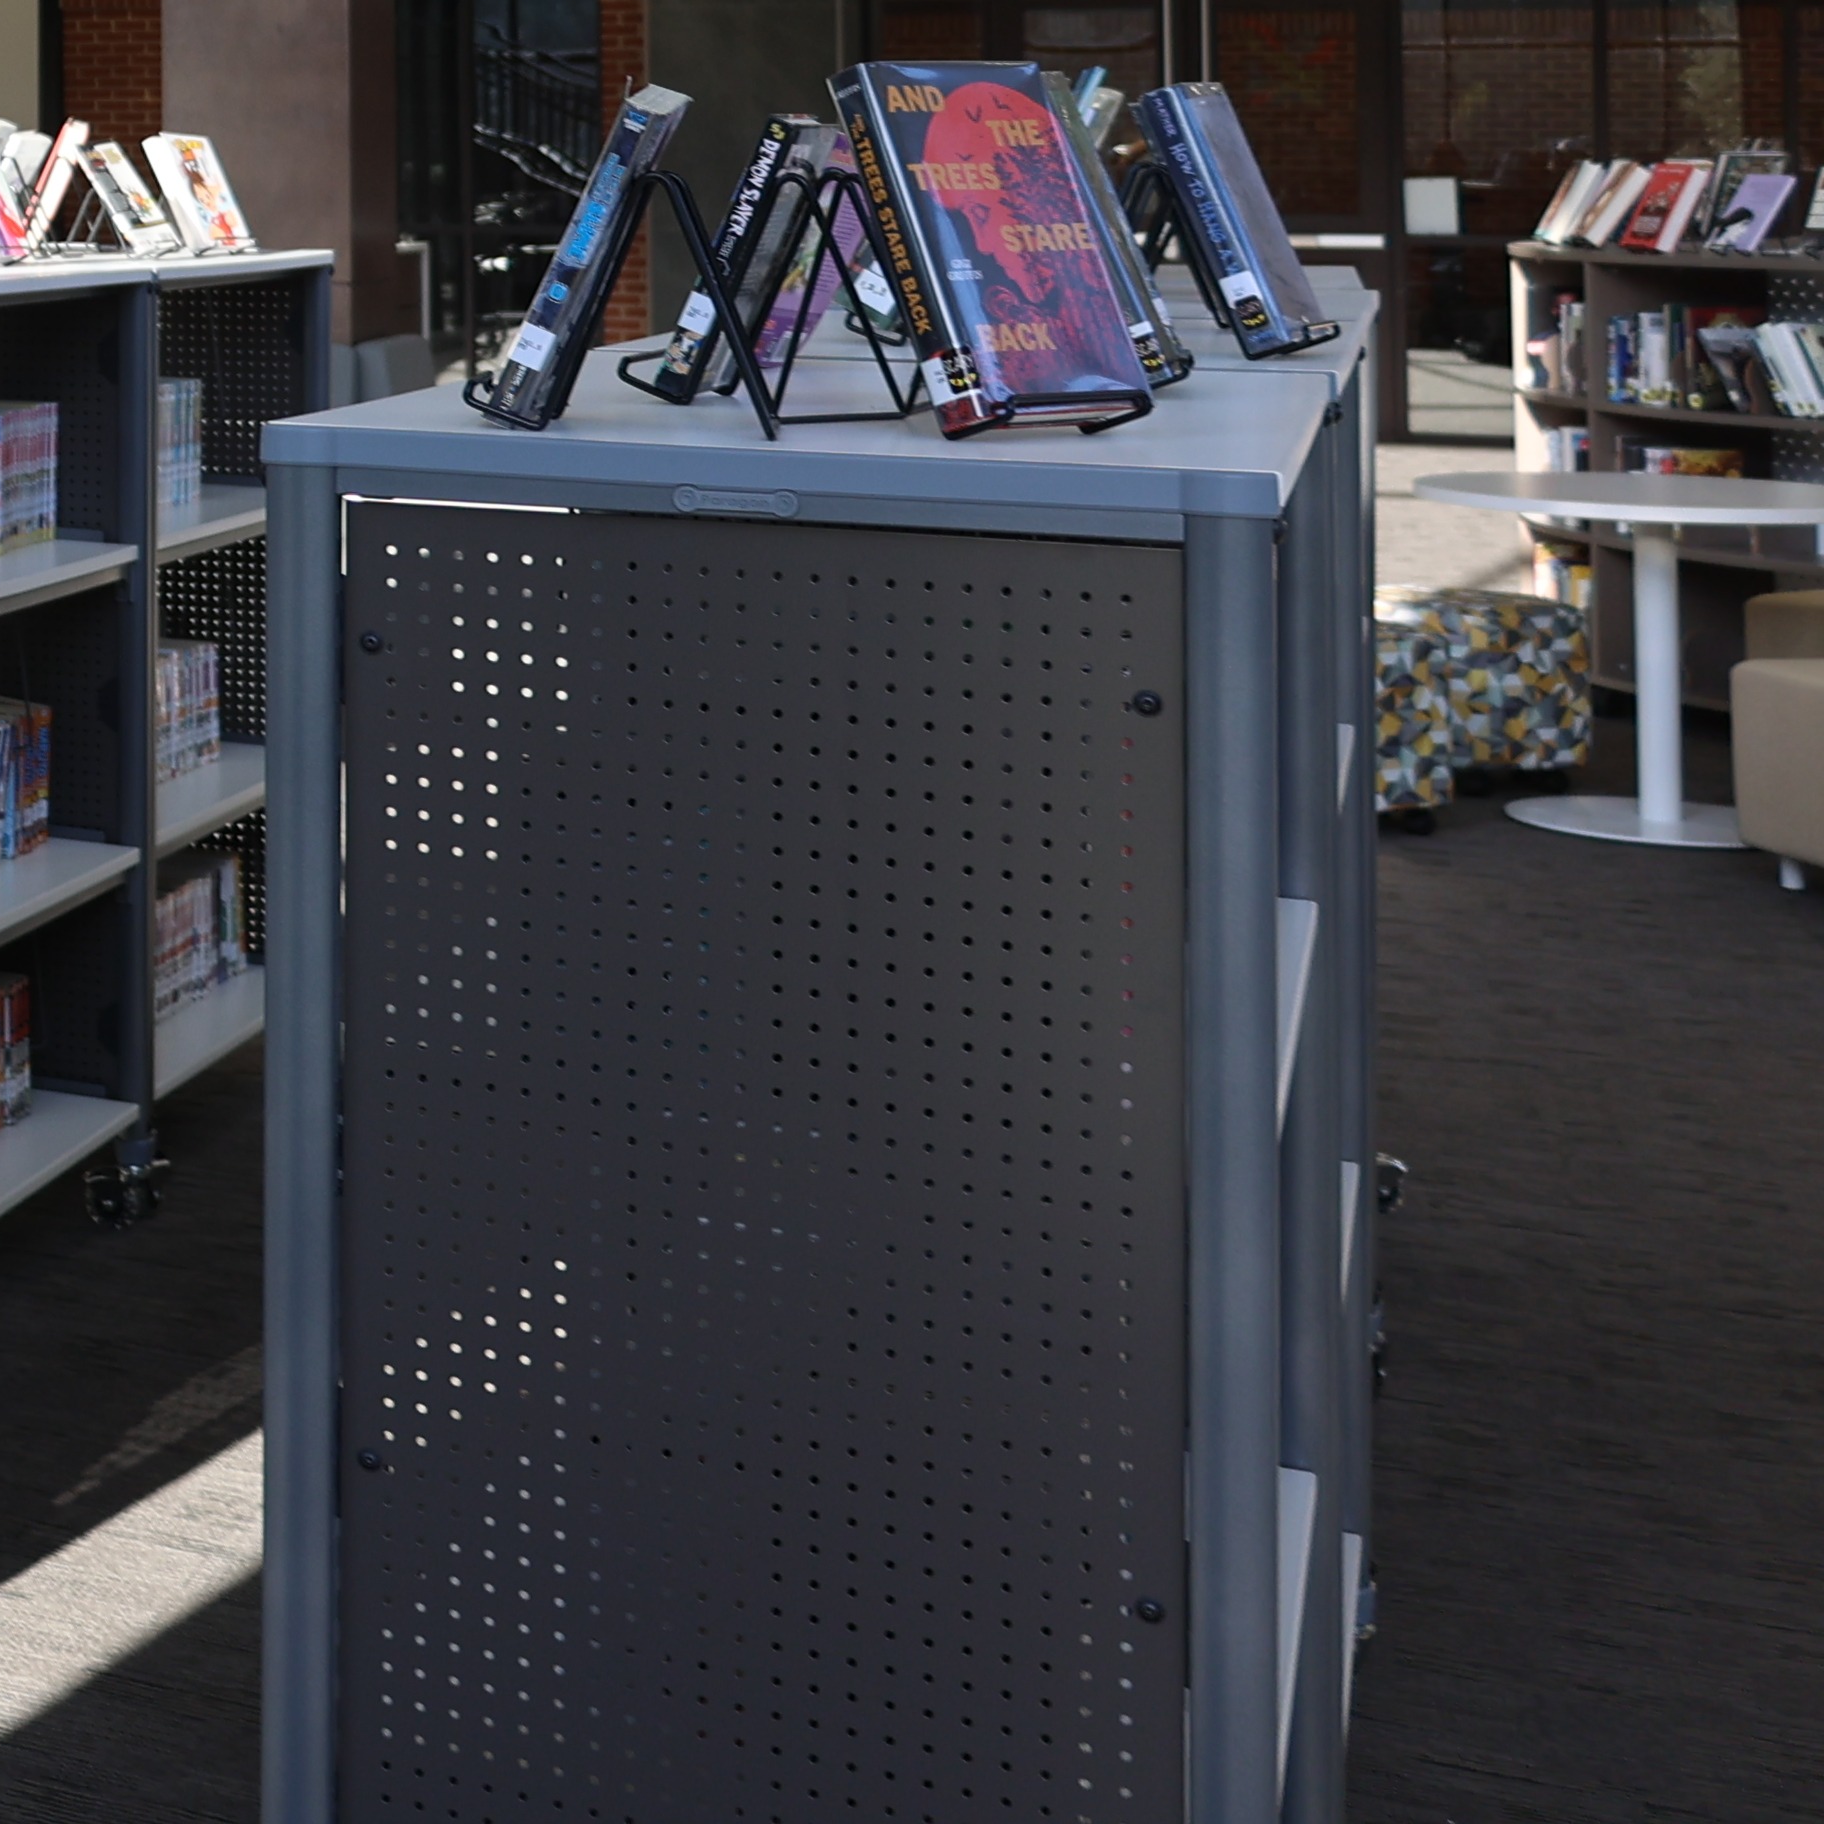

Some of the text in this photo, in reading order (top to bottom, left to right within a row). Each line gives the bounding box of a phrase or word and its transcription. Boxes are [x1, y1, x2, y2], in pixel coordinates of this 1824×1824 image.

[887, 85, 945, 113] AND
[985, 119, 1047, 146] THE
[729, 137, 781, 236] DEMON SLAYER
[906, 162, 1001, 191] TREES
[1169, 143, 1195, 176] HOW
[1188, 179, 1206, 198] TO
[1200, 200, 1227, 244] HANG
[856, 136, 888, 204] TREES
[878, 206, 910, 274] STARE
[902, 276, 933, 335] BACK
[1002, 223, 1097, 252] STARE
[976, 323, 1057, 350] BACK
